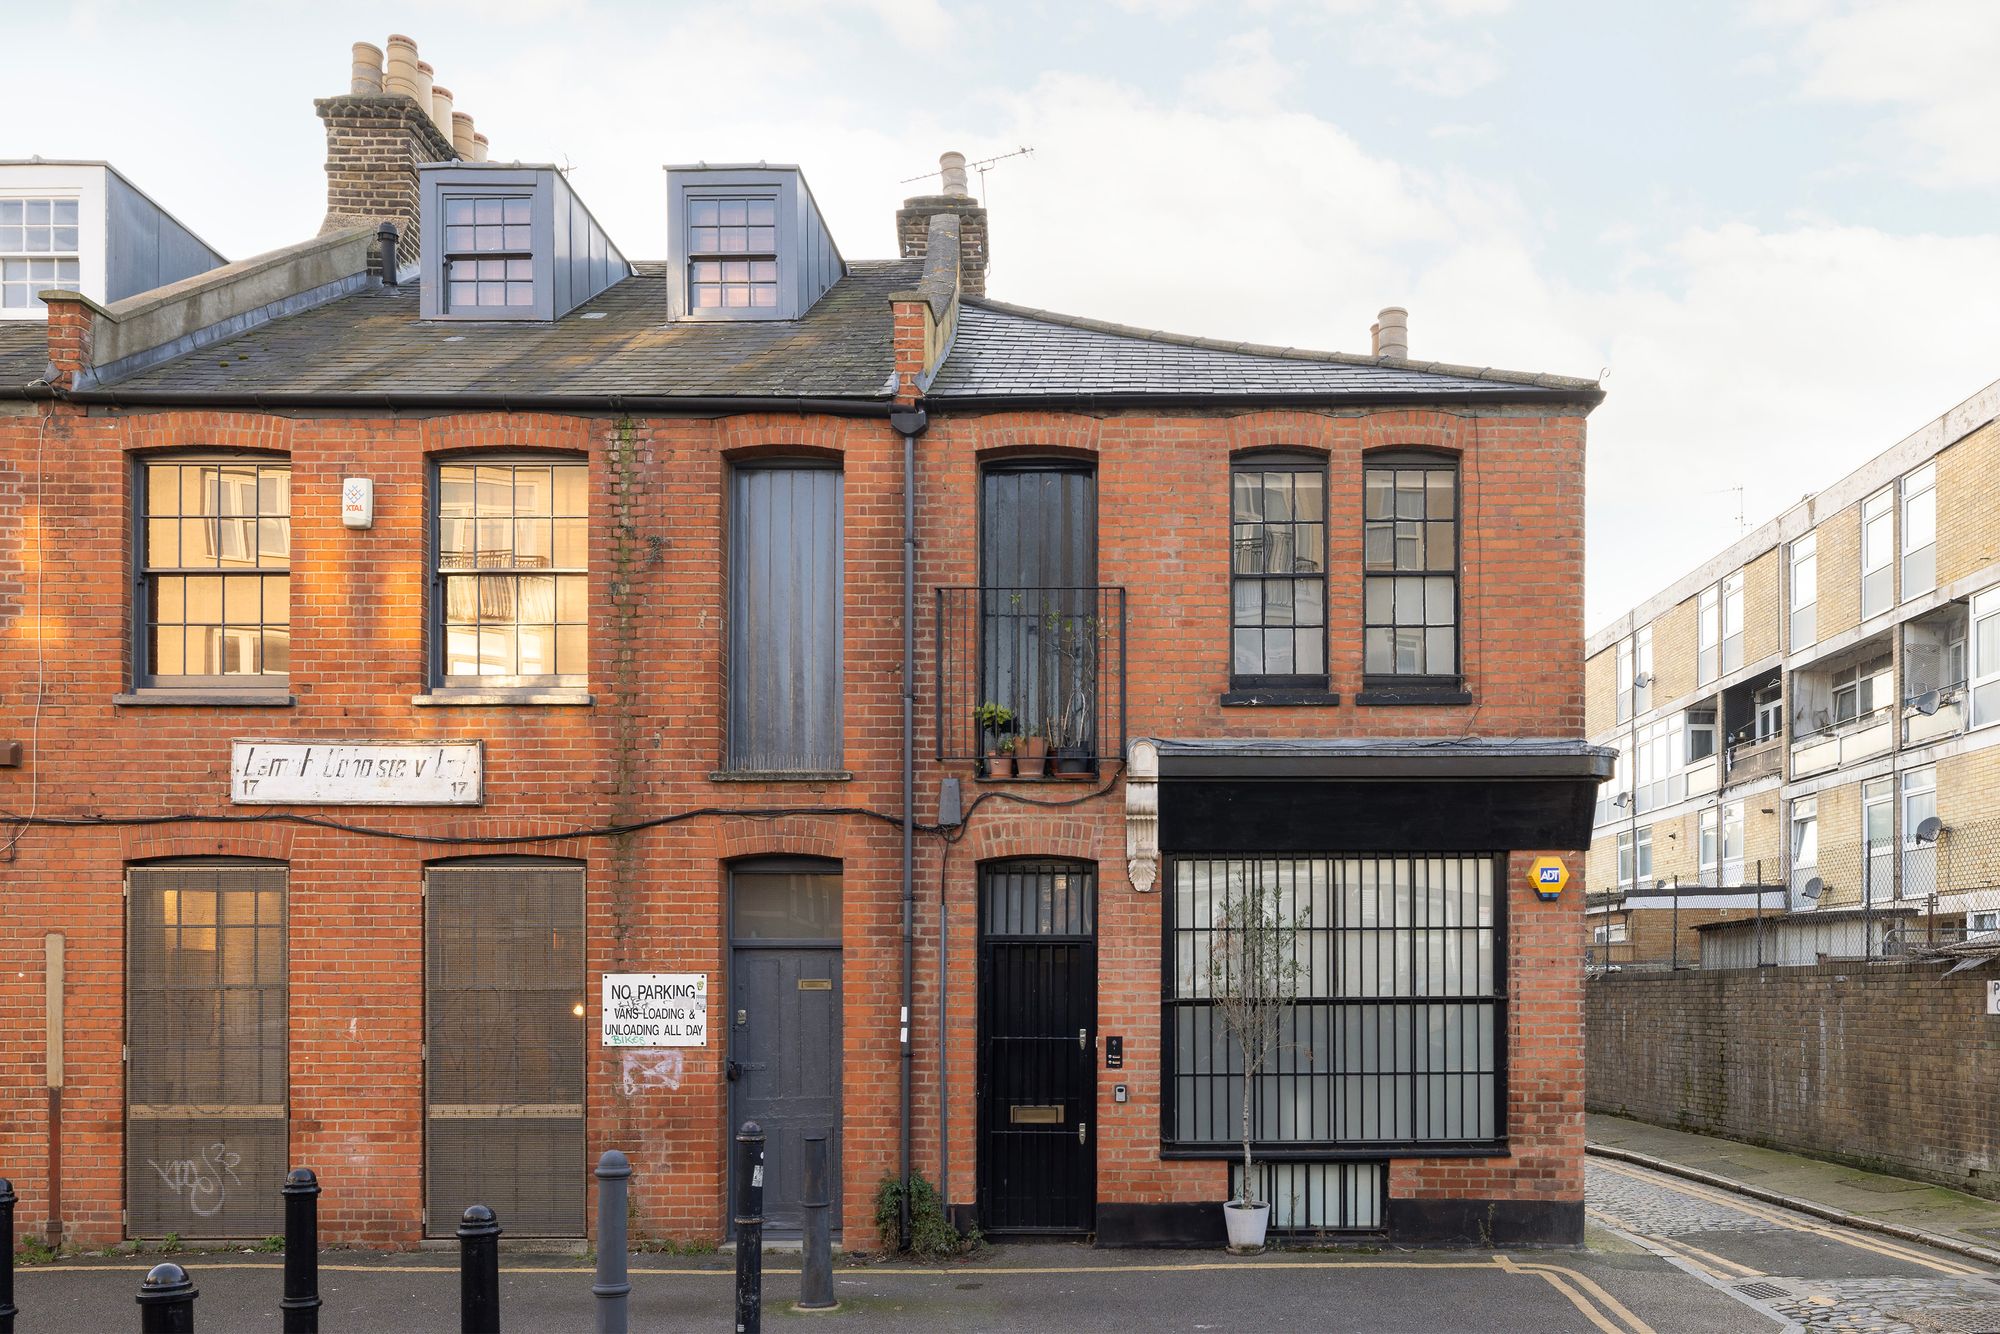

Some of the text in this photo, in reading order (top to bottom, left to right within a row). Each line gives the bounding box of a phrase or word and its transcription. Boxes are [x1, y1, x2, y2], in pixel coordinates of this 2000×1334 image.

[242, 779, 260, 796] 17
[450, 781, 469, 797] 17
[1540, 870, 1559, 881] ADT
[611, 984, 696, 1000] NO PARKING
[614, 1008, 696, 1020] VANS LOADING &
[604, 1024, 704, 1036] UNLOADING ALL DAY
